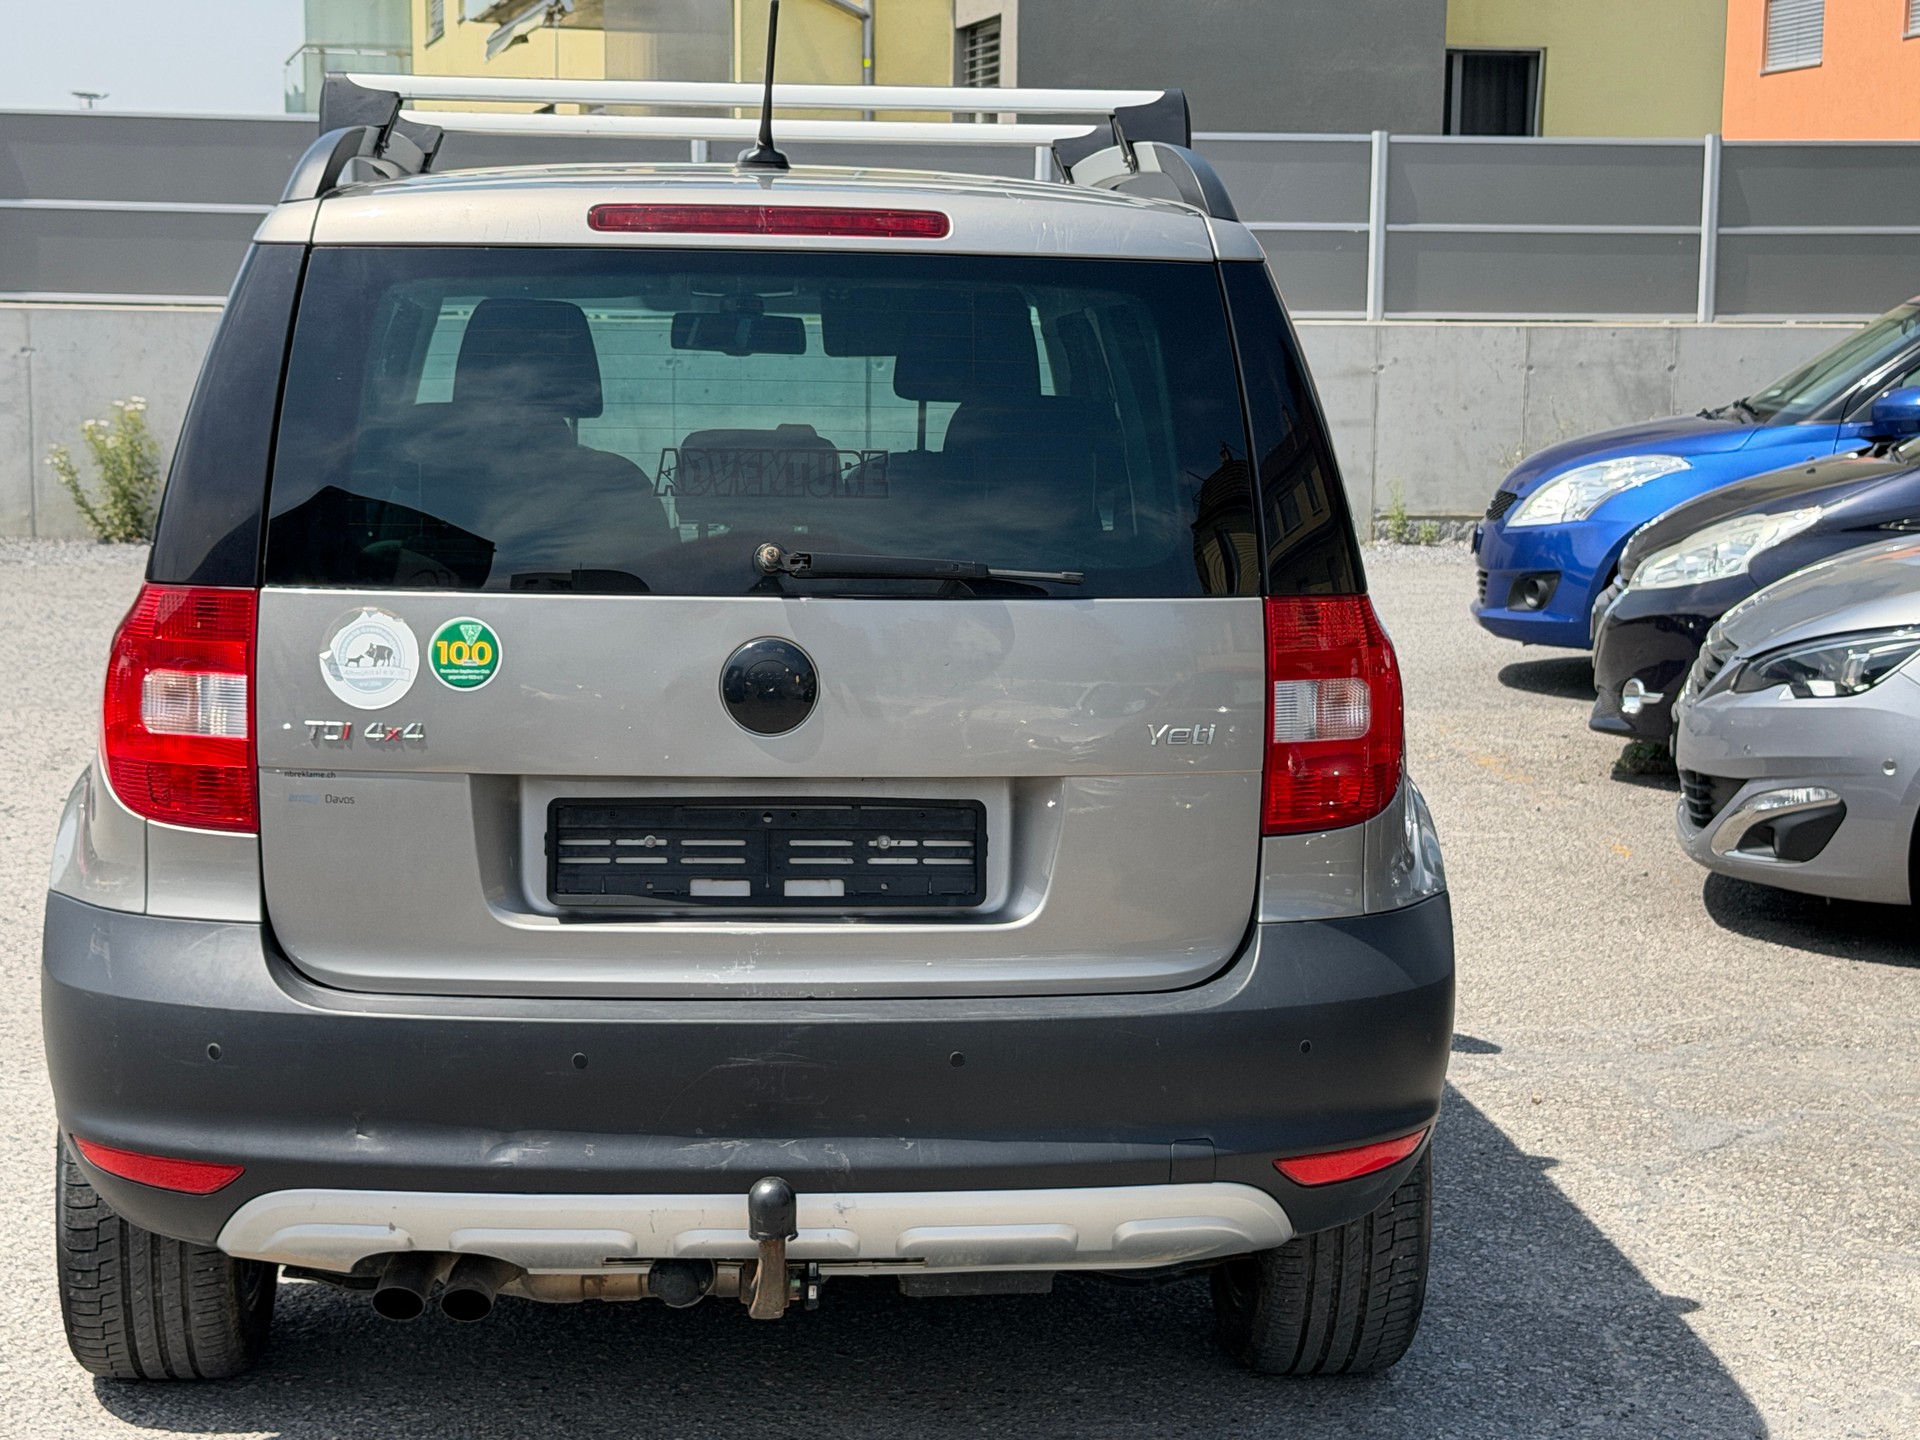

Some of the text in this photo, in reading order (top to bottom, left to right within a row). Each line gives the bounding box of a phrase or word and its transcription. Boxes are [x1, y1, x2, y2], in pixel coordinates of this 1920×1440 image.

[653, 447, 891, 498] ADVENTURE
[436, 641, 493, 666] 100
[304, 720, 425, 742] TDI 4x4
[1147, 723, 1216, 746] Yeti
[325, 793, 356, 805] Davos
